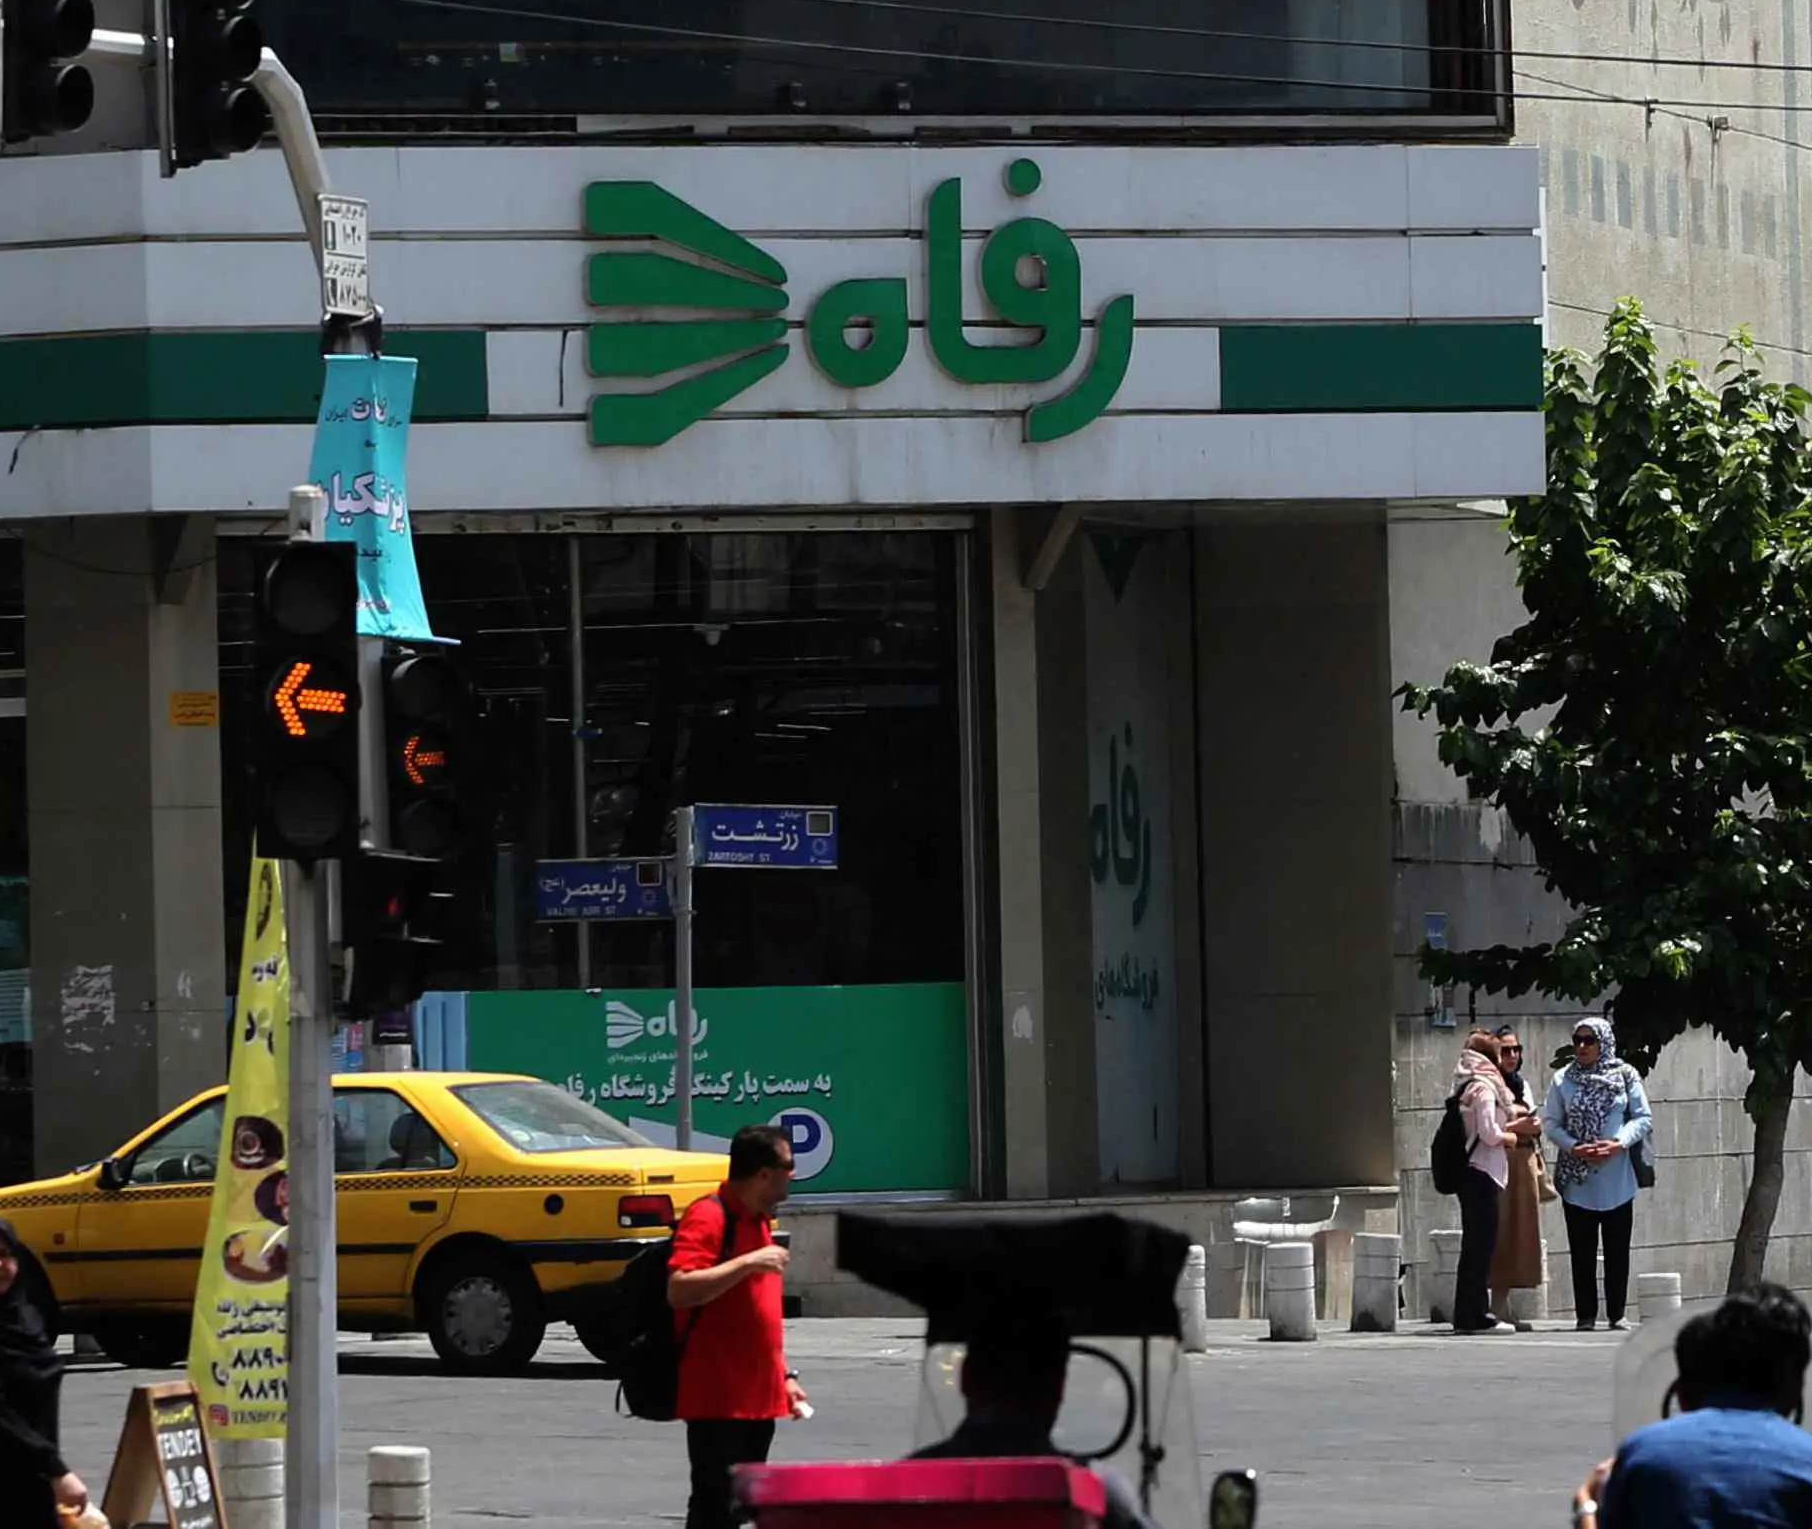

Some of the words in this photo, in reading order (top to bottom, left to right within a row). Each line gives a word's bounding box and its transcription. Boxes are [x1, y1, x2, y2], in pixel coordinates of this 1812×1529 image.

[807, 157, 1134, 443] رفاه
[711, 820, 800, 851] زرتشت
[1090, 721, 1151, 927] رفاه
[561, 877, 628, 904] ولیعصر
[763, 1072, 810, 1097] سمت
[814, 1072, 833, 1100] به
